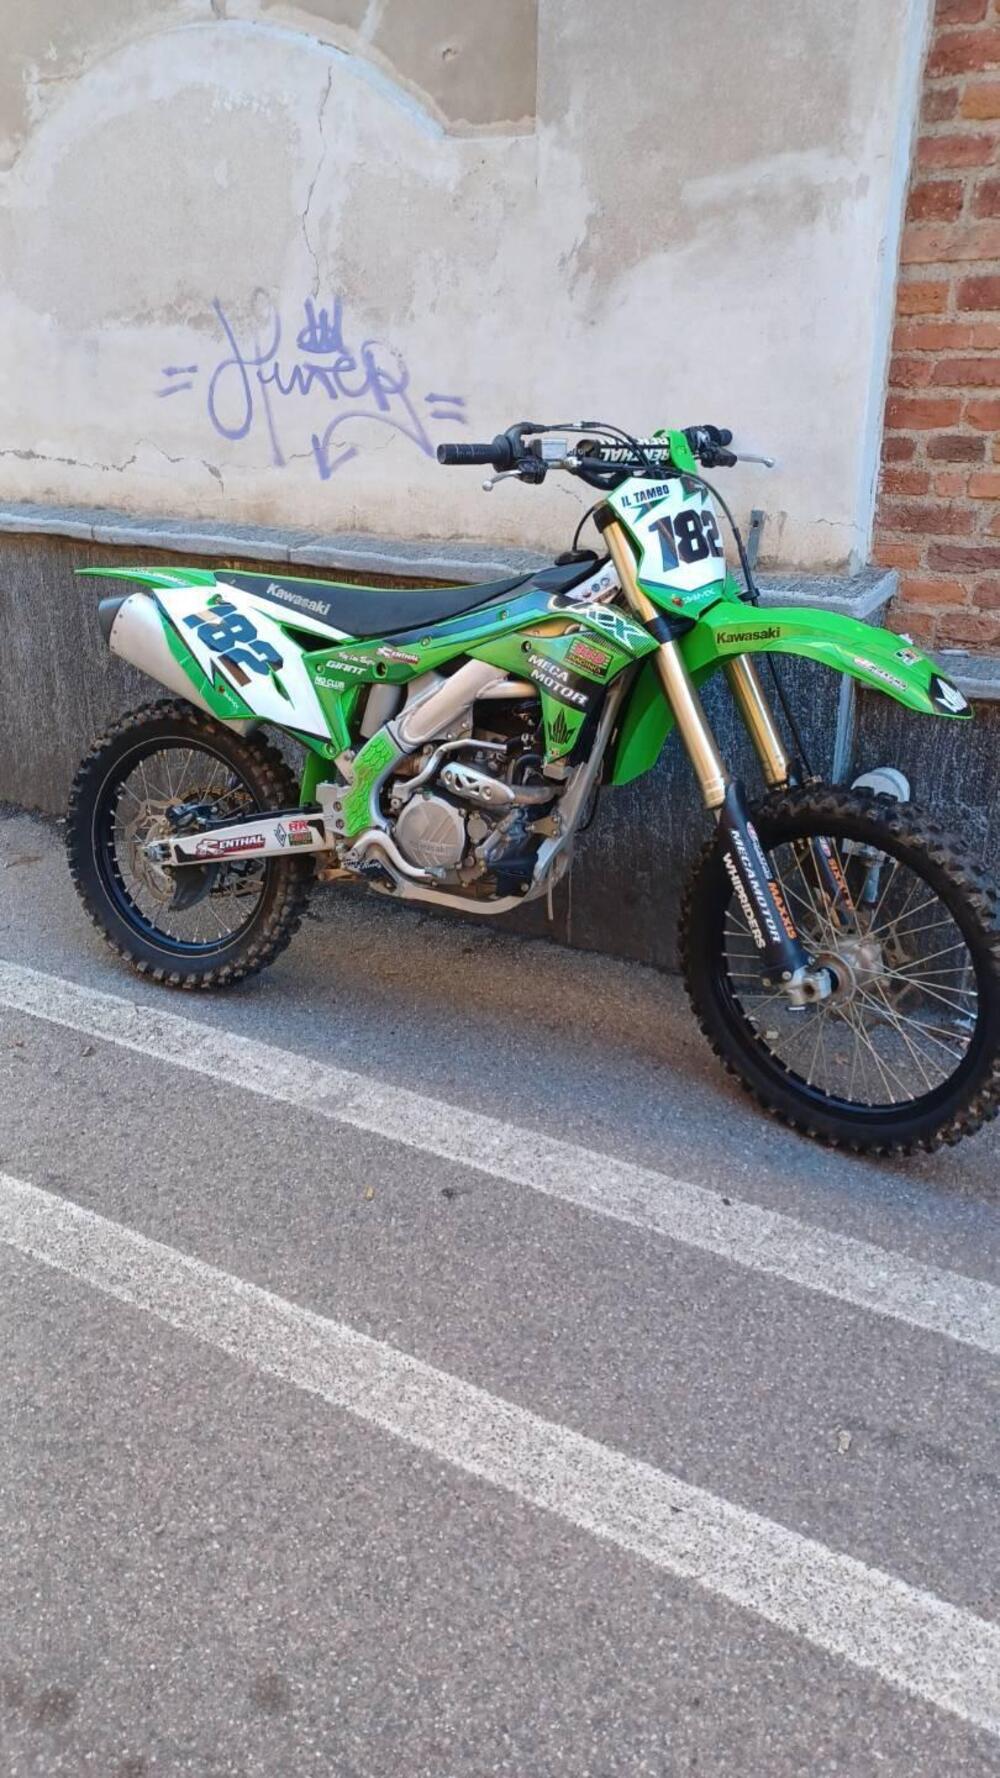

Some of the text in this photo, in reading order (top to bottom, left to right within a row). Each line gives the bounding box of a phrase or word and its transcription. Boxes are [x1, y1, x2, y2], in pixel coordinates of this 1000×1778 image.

[620, 484, 670, 507] IL TAMBO
[648, 509, 724, 573] 182
[266, 582, 331, 615] Kawasaki
[182, 602, 284, 687] 182
[716, 626, 781, 644] Kawasaki
[530, 669, 589, 707] MOTOR
[196, 834, 266, 858] RENTHAL
[723, 852, 767, 949] WHIPRIDERS
[767, 881, 797, 940] MAXXIS
